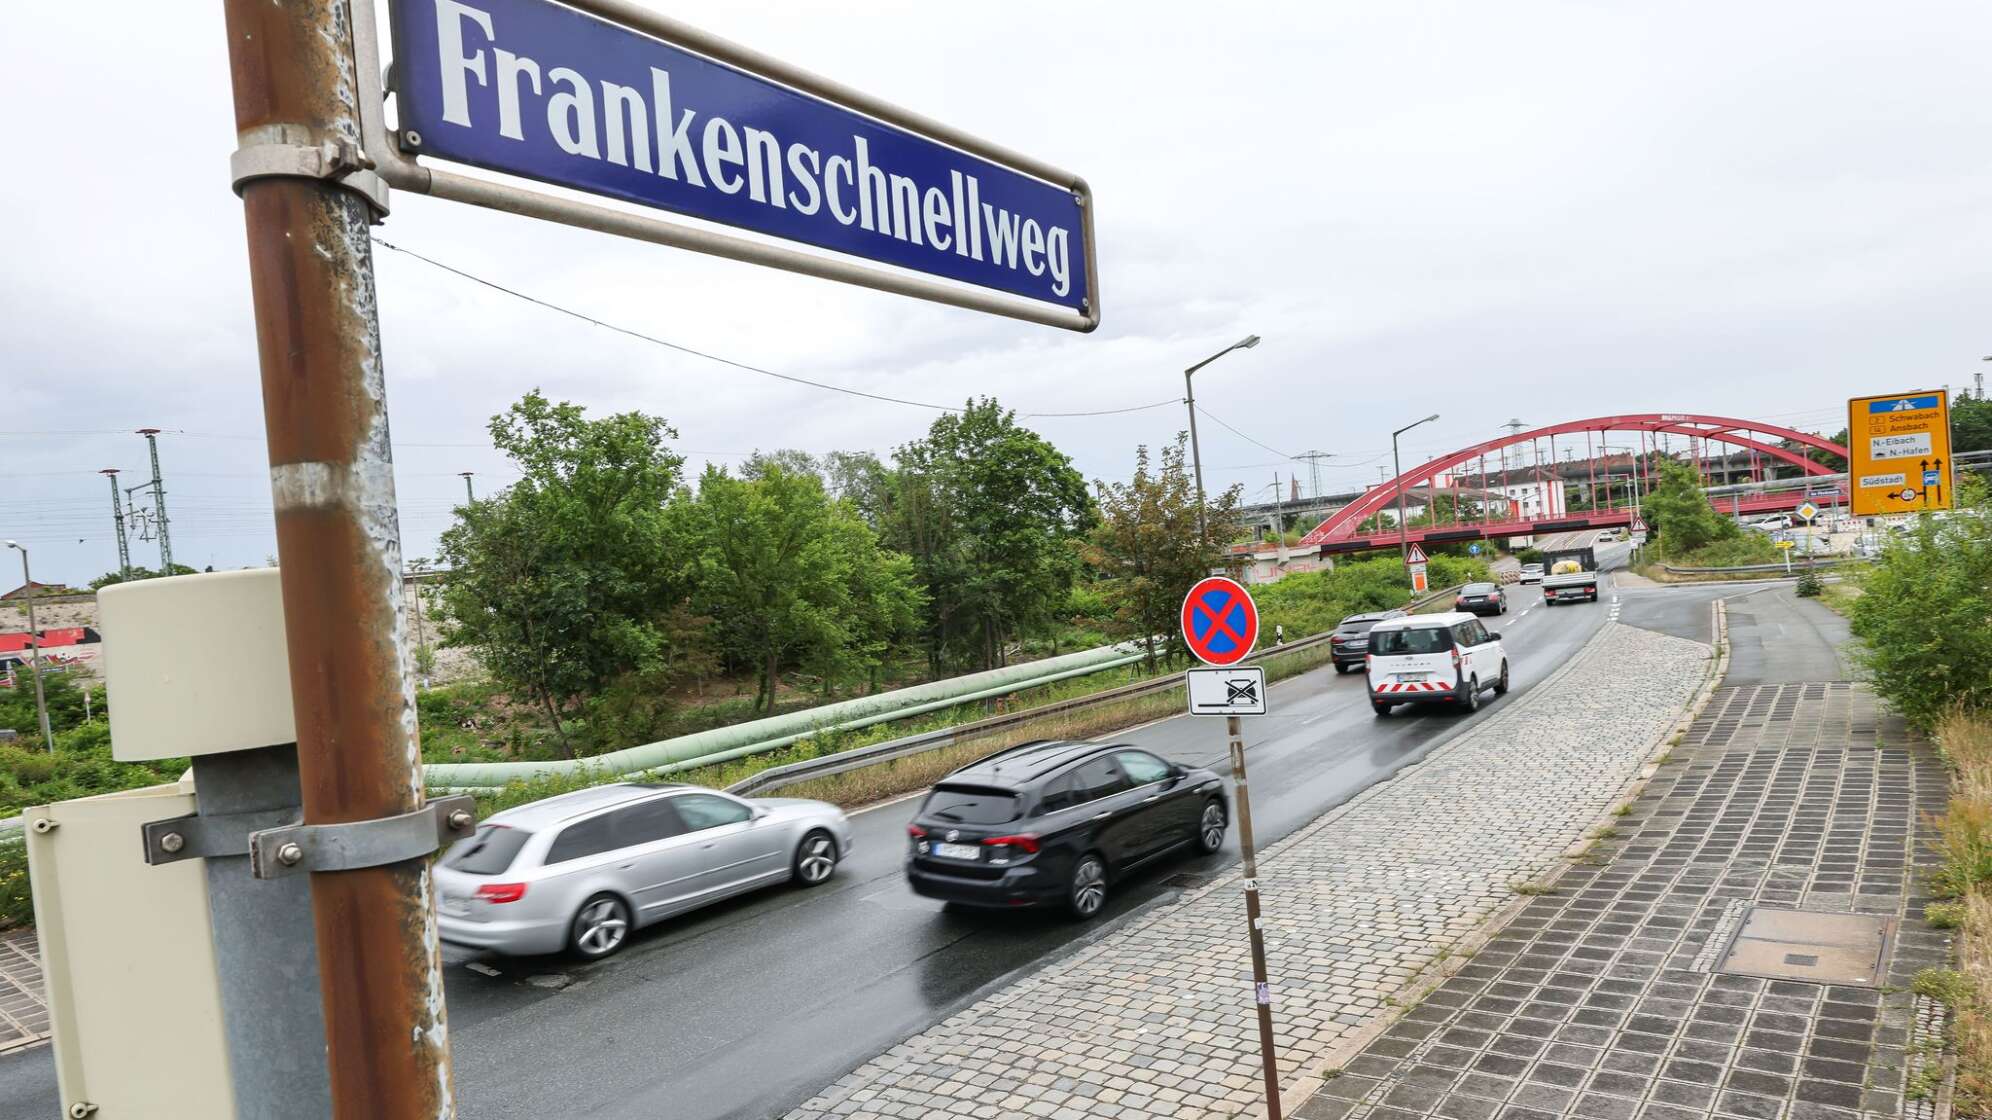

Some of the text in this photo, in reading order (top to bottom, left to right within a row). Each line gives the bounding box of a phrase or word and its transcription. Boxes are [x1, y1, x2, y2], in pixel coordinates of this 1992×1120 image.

[436, 0, 1071, 298] Frankenschnellweg
[1889, 412, 1939, 422] Schwabach
[1890, 423, 1928, 432] Ansbach
[1863, 476, 1903, 486] Südstadt
